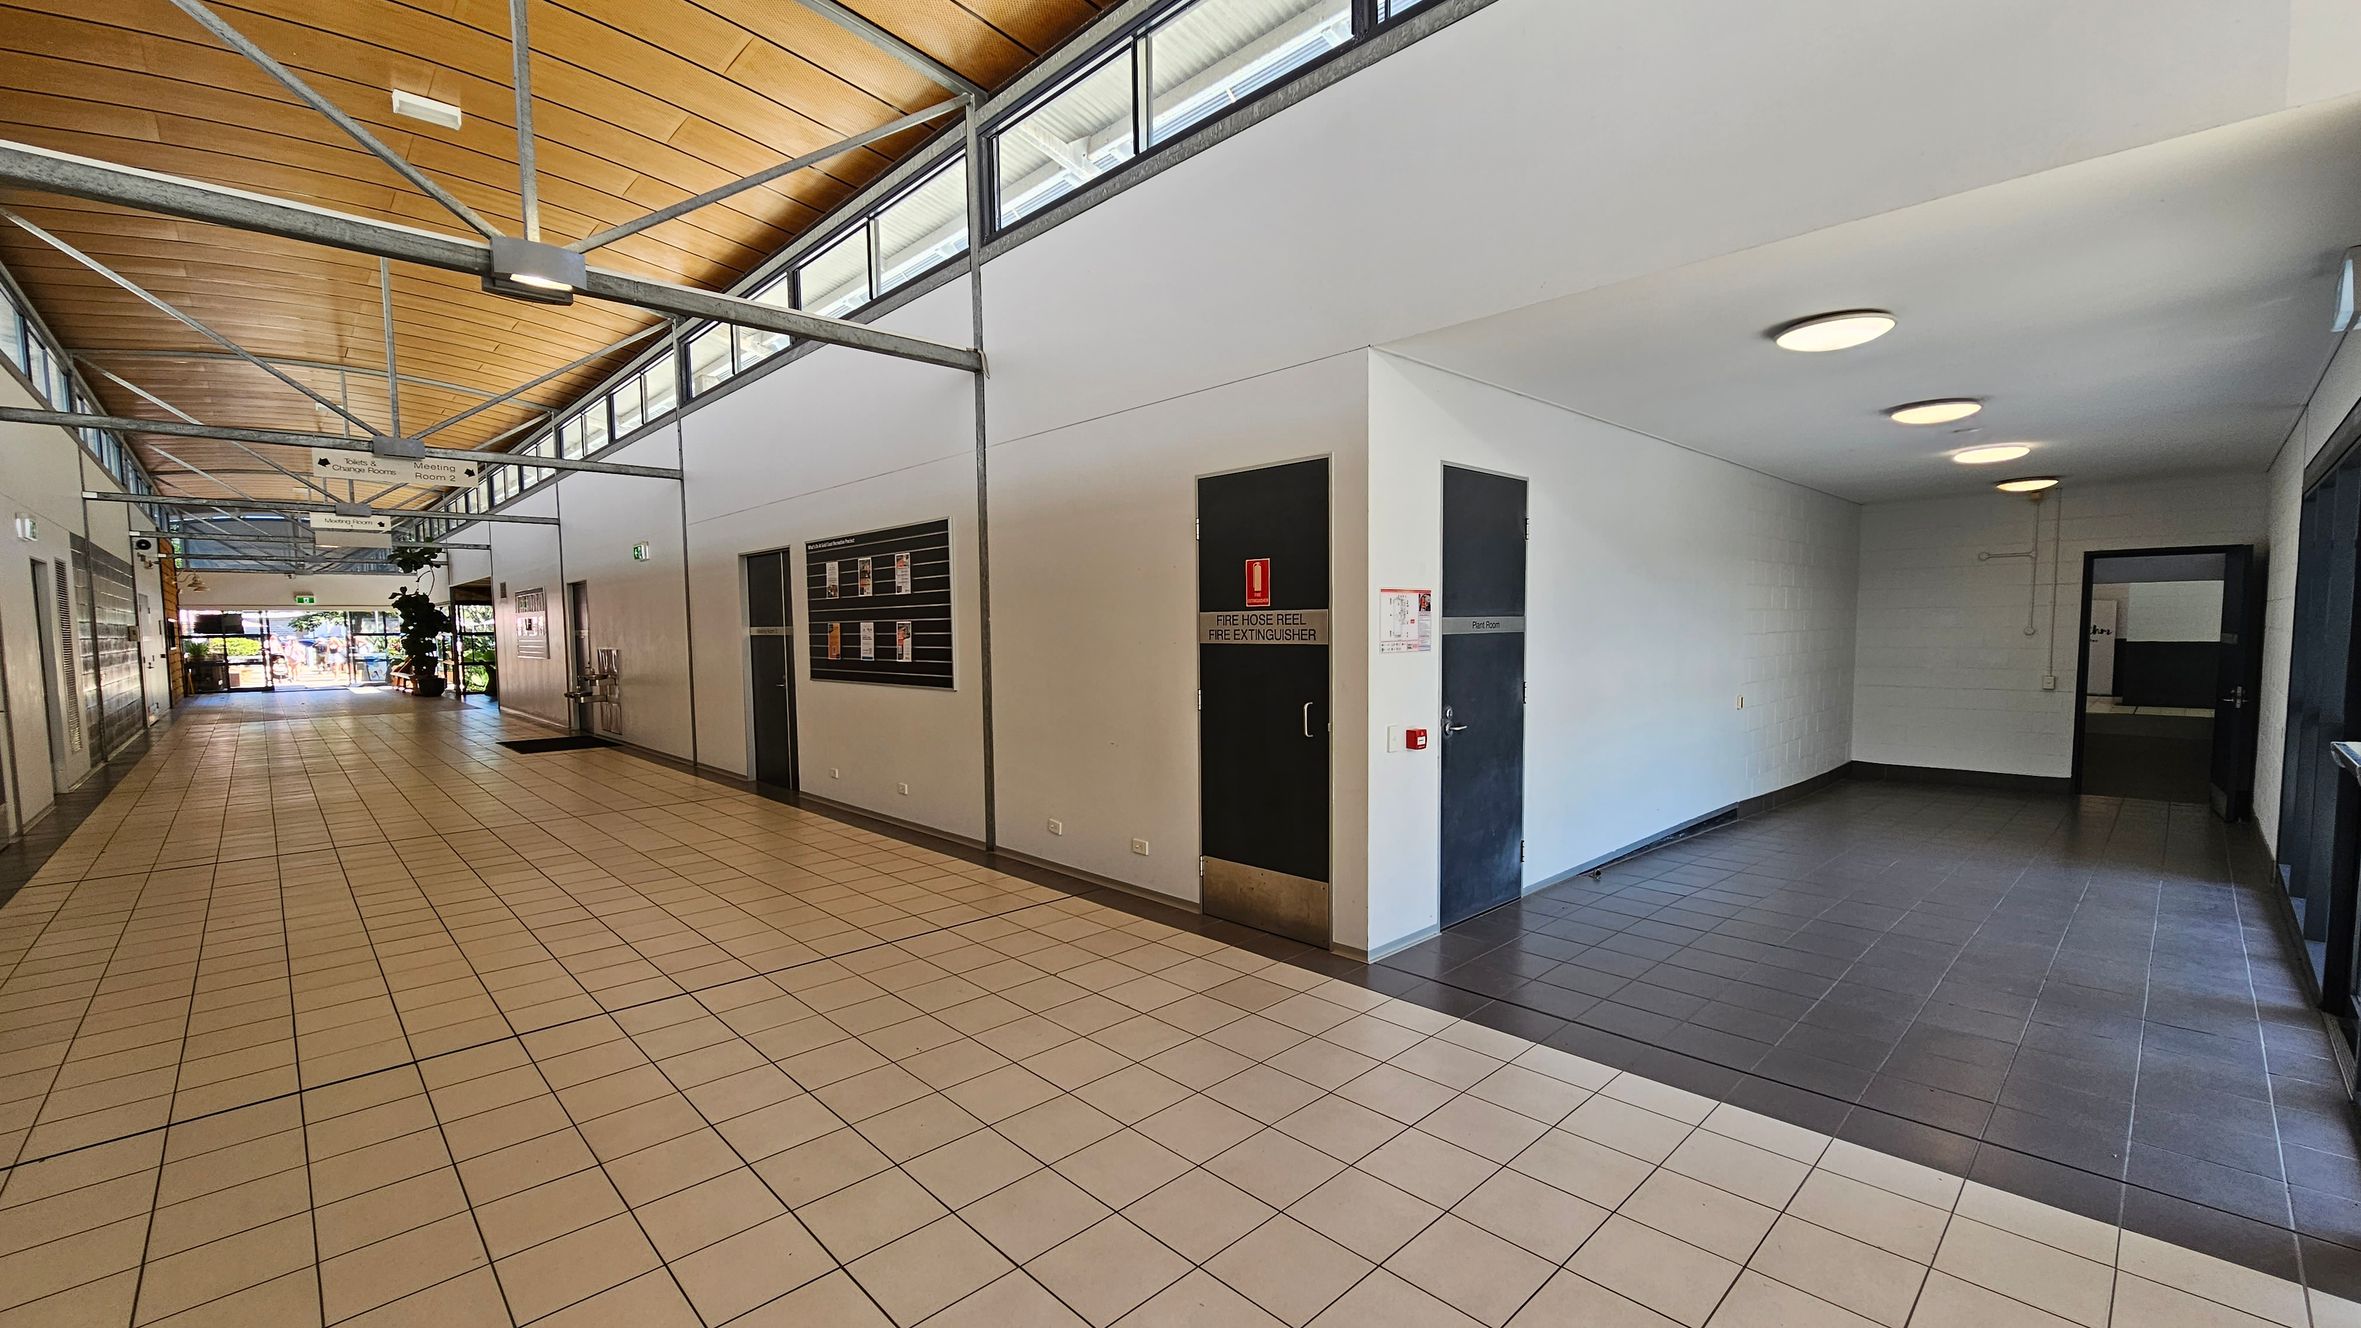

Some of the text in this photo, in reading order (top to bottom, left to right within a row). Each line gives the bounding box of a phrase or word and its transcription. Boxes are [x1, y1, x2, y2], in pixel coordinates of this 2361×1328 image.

[344, 458, 368, 466] Toilets
[413, 462, 456, 472] Meeting
[332, 464, 397, 476] Change Rooms
[415, 472, 456, 482] Room 2
[324, 518, 351, 526] Meeting
[1216, 613, 1307, 626] FIRE HOSE REEL
[1472, 620, 1500, 629] Plant Room
[1208, 628, 1317, 641] FIRE EXTINGUISHER
